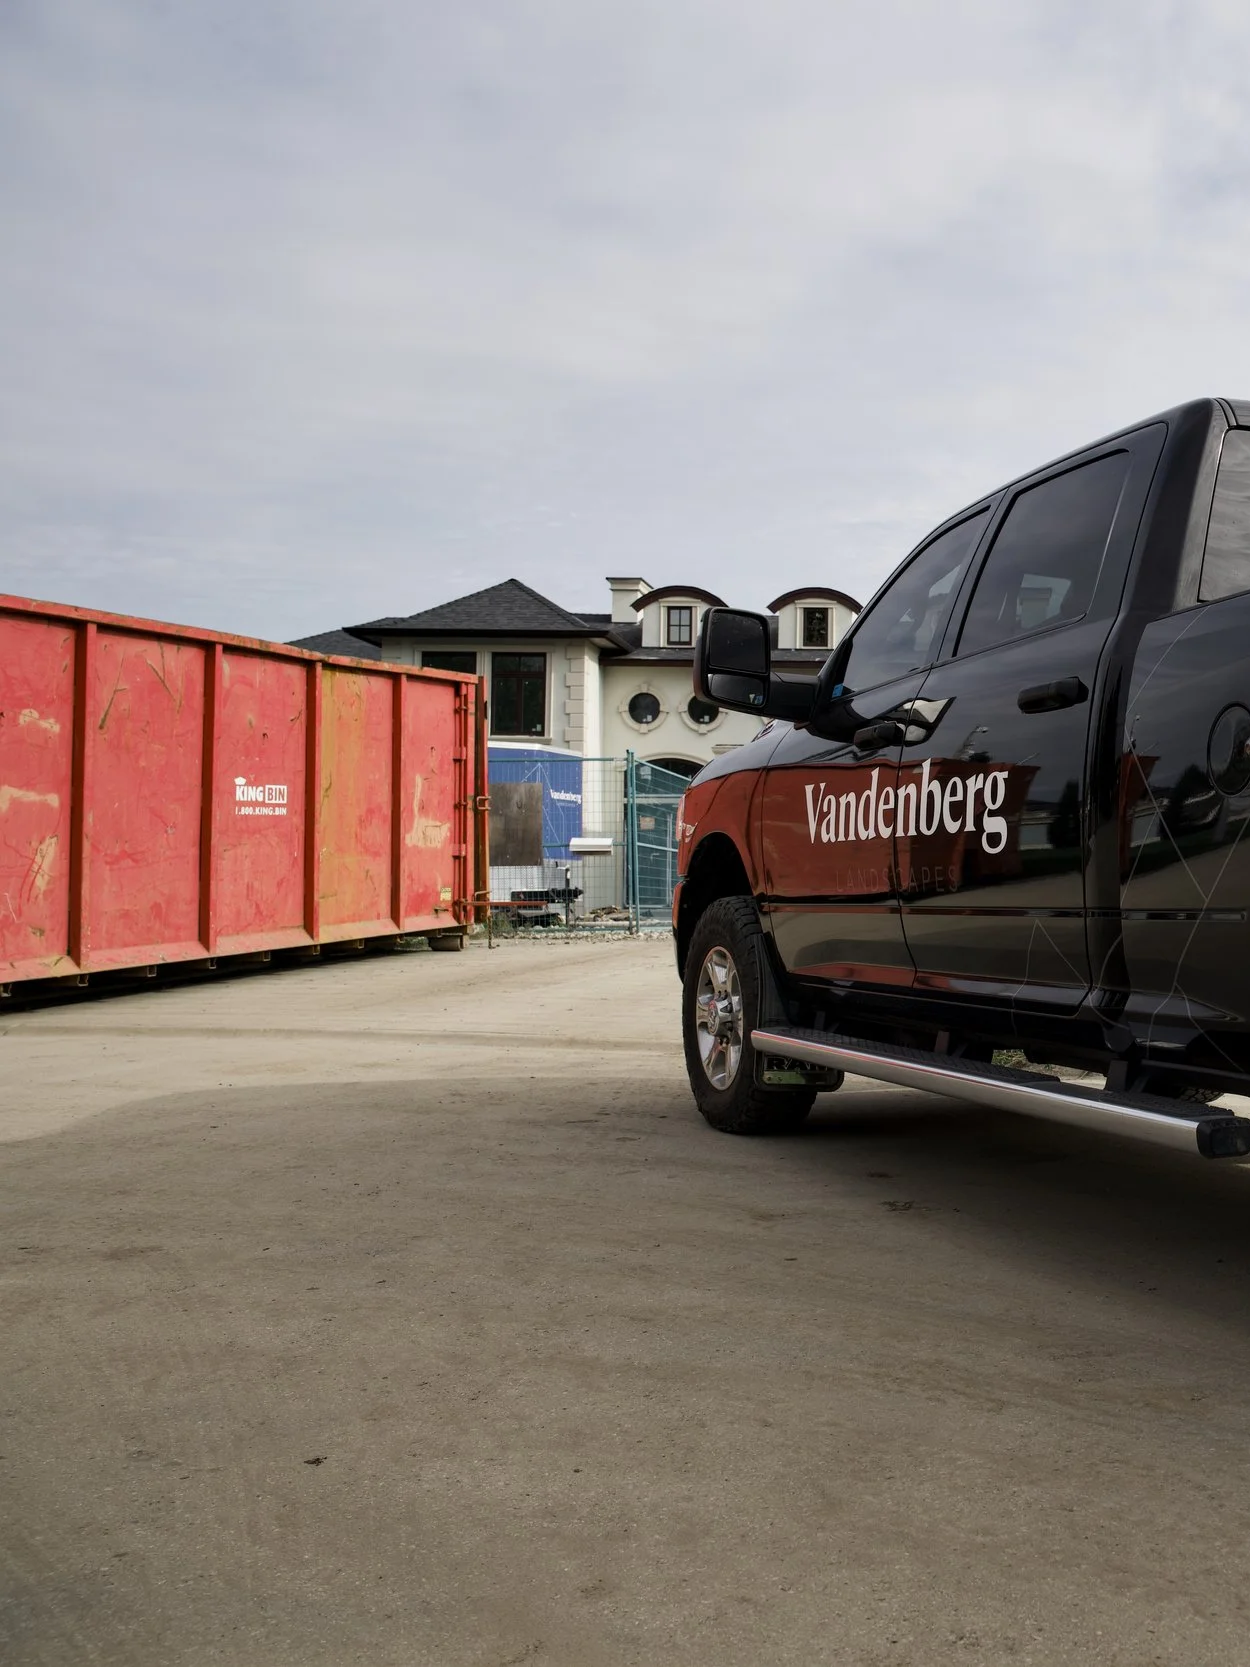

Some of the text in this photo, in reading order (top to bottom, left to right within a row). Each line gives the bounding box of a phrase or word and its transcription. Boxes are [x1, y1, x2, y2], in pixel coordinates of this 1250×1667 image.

[235, 785, 287, 804] KING BIN
[804, 757, 1009, 855] Vandenberg
[836, 865, 959, 893] LANDSCAPES
